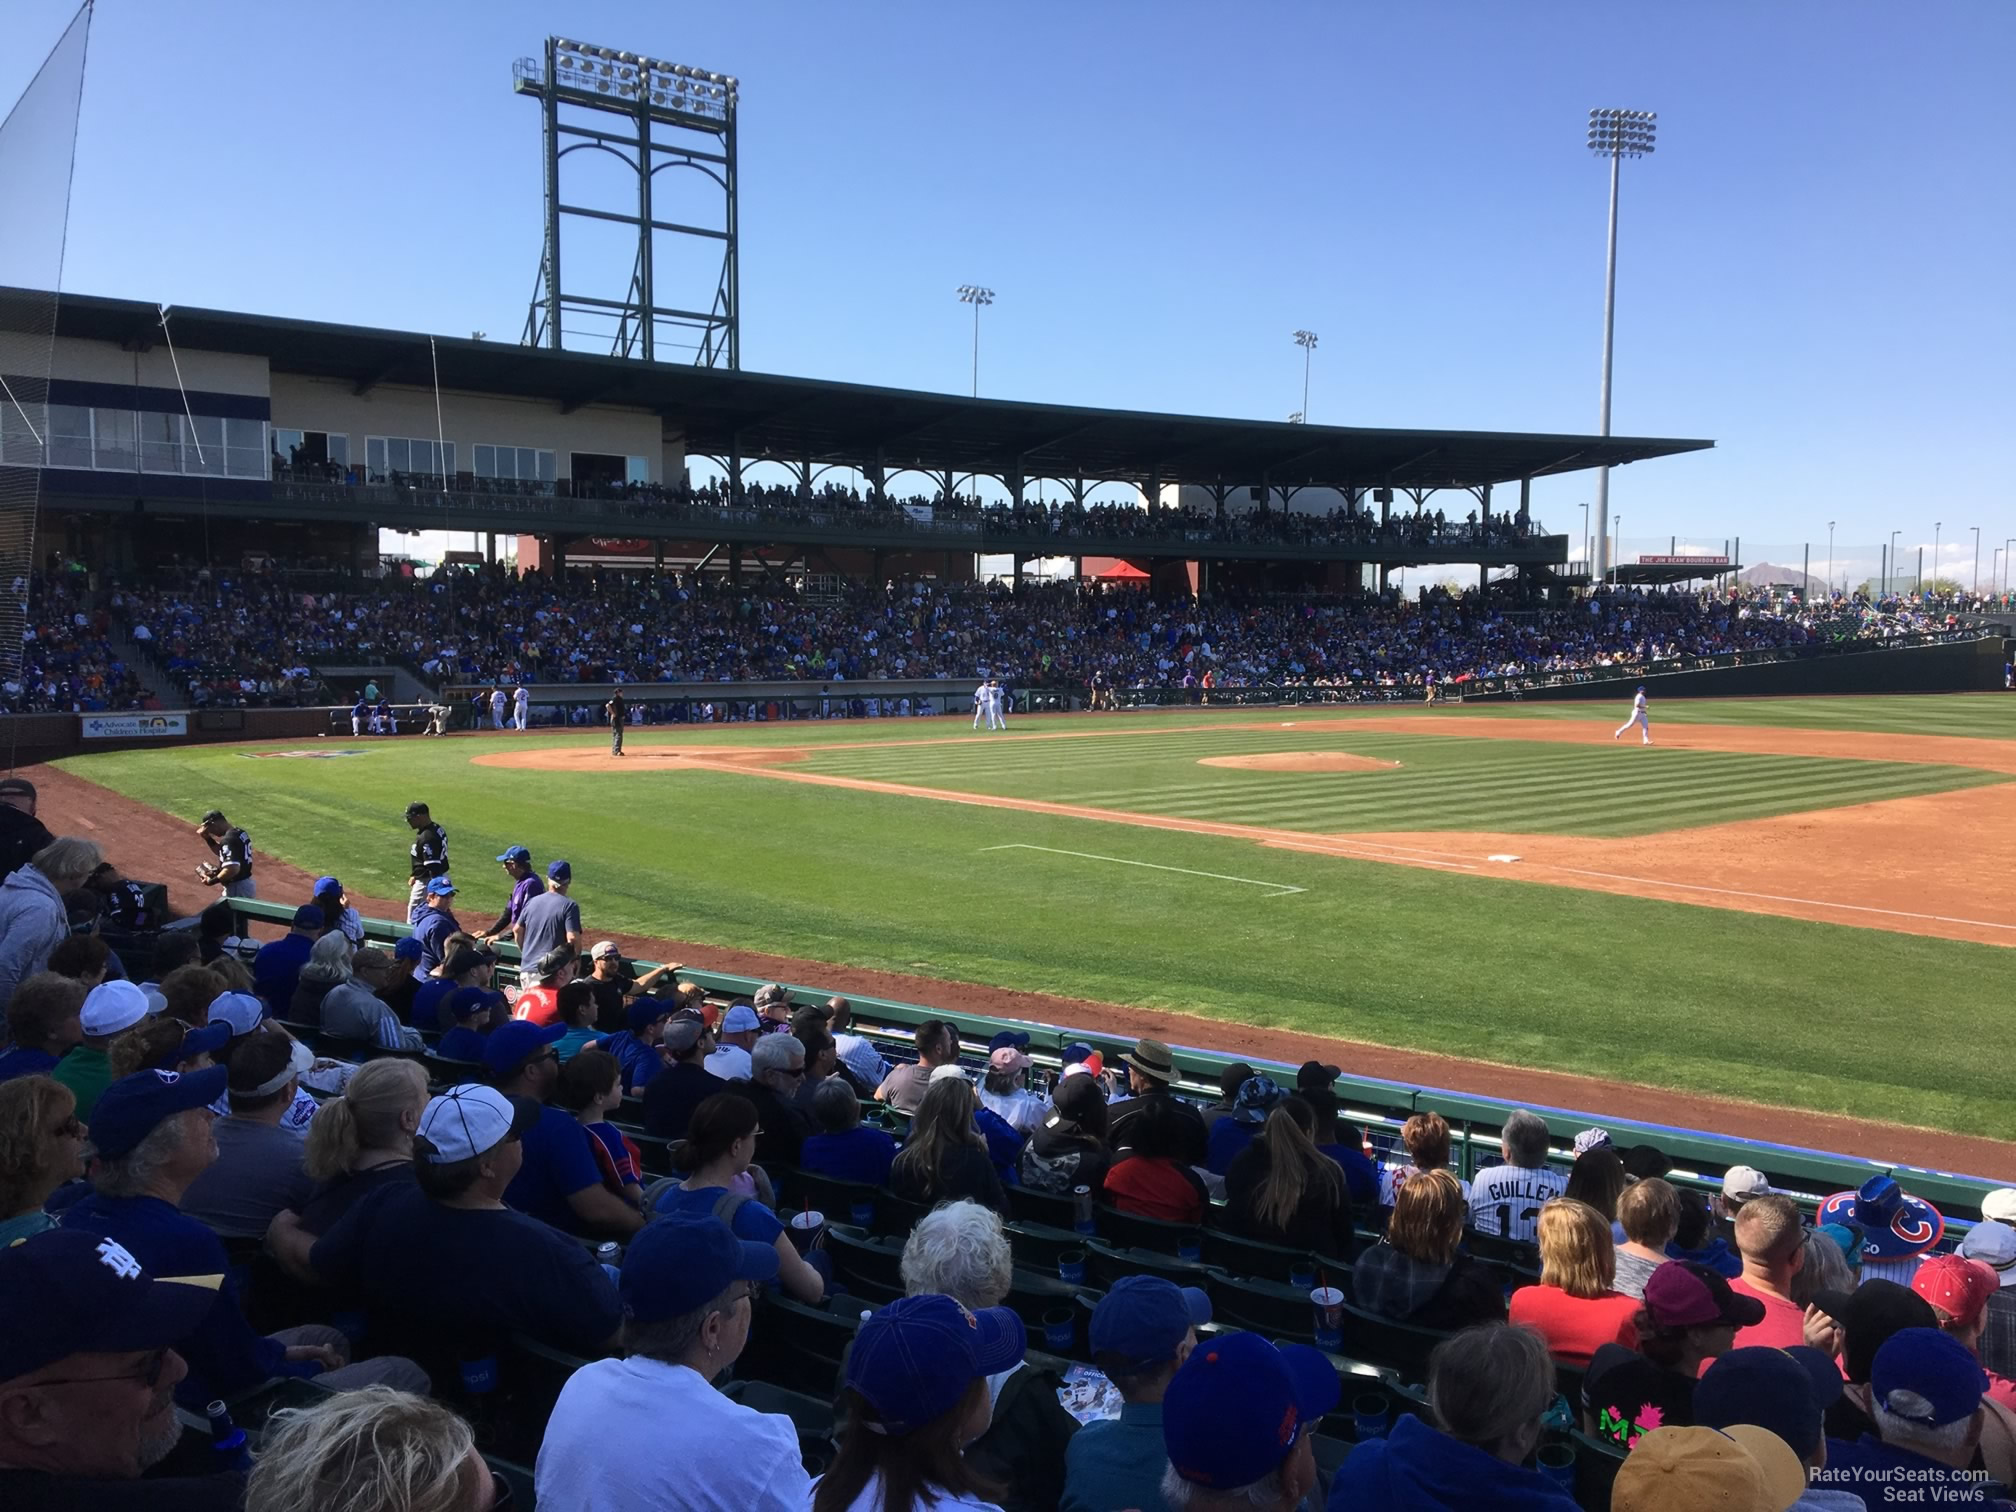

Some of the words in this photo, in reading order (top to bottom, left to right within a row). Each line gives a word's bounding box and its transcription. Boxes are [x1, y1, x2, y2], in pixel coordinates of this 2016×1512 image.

[1715, 557, 1728, 565] BAR
[103, 728, 138, 736] Children's
[140, 728, 167, 736] Hospital
